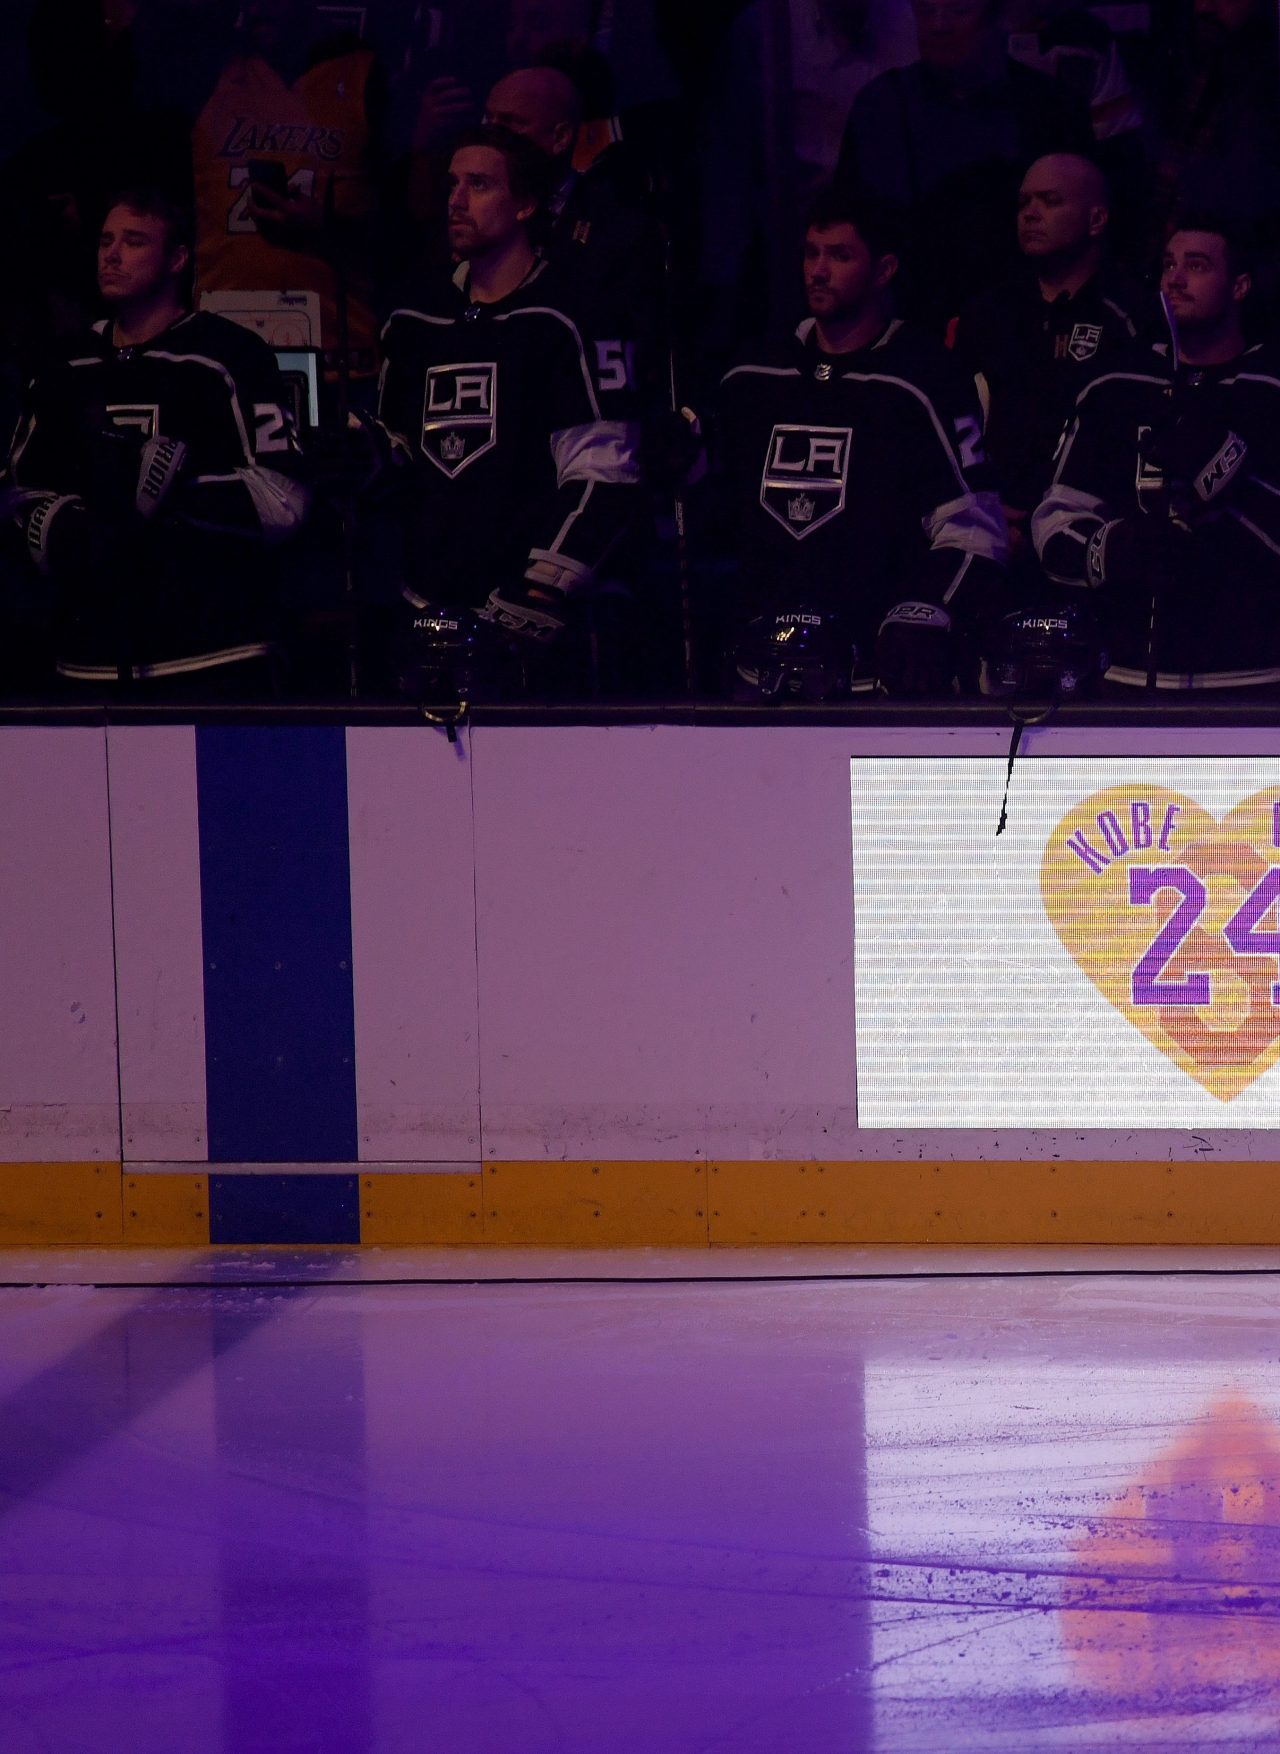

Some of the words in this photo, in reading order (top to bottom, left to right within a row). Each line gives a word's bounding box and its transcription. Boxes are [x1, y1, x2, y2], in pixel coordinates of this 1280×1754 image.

[214, 117, 346, 161] LAKERS
[594, 339, 637, 391] 5
[427, 374, 490, 412] LA
[252, 402, 298, 454] 2
[771, 435, 846, 473] LA
[413, 617, 459, 631] KINGS
[776, 613, 821, 625] KINGS
[1022, 618, 1068, 630] KINGS
[1066, 801, 1181, 874] KOBE
